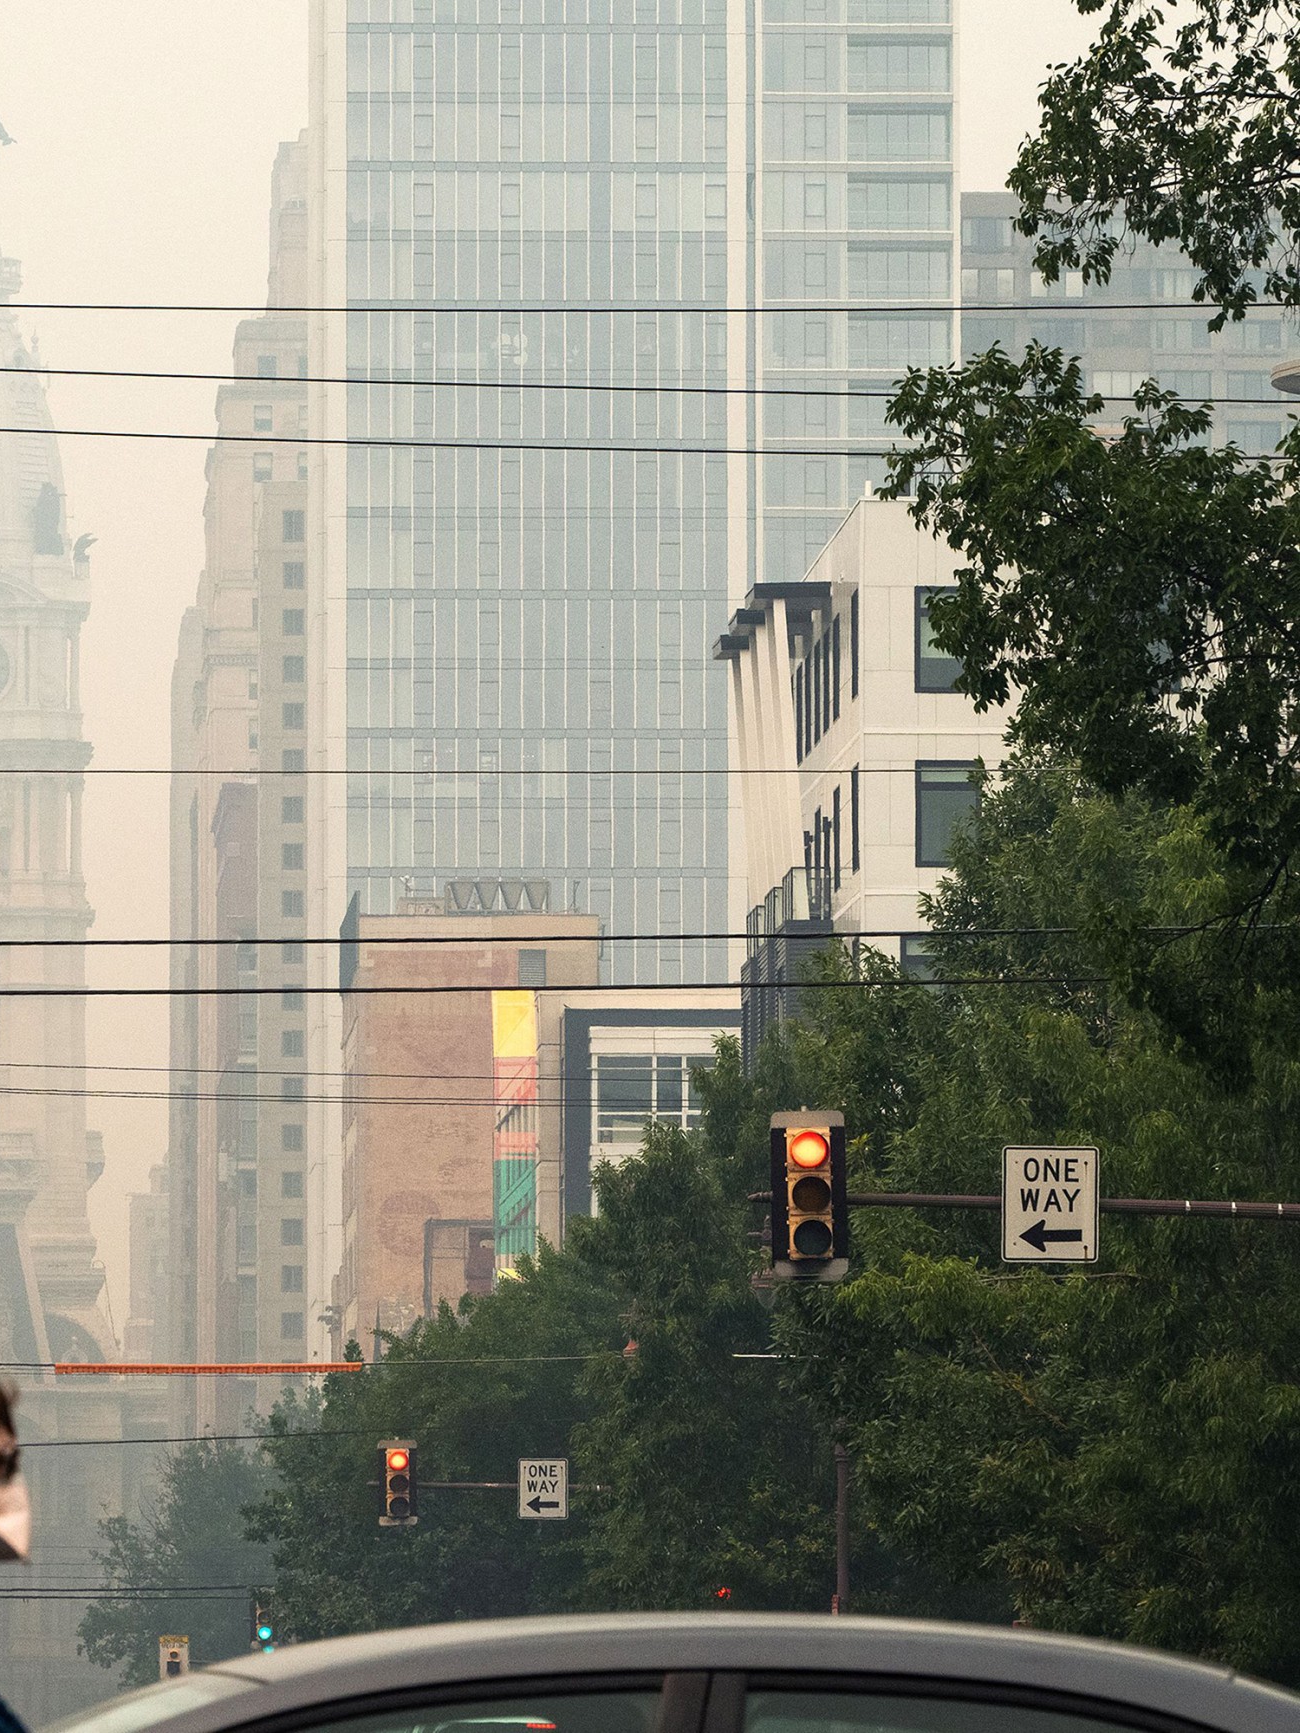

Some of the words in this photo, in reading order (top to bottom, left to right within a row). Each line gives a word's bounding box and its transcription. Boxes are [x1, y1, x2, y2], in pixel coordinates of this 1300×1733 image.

[1023, 1158, 1079, 1182] ONE
[1020, 1188, 1081, 1212] WAY
[529, 1465, 558, 1477] ONE
[527, 1480, 558, 1493] WAY
